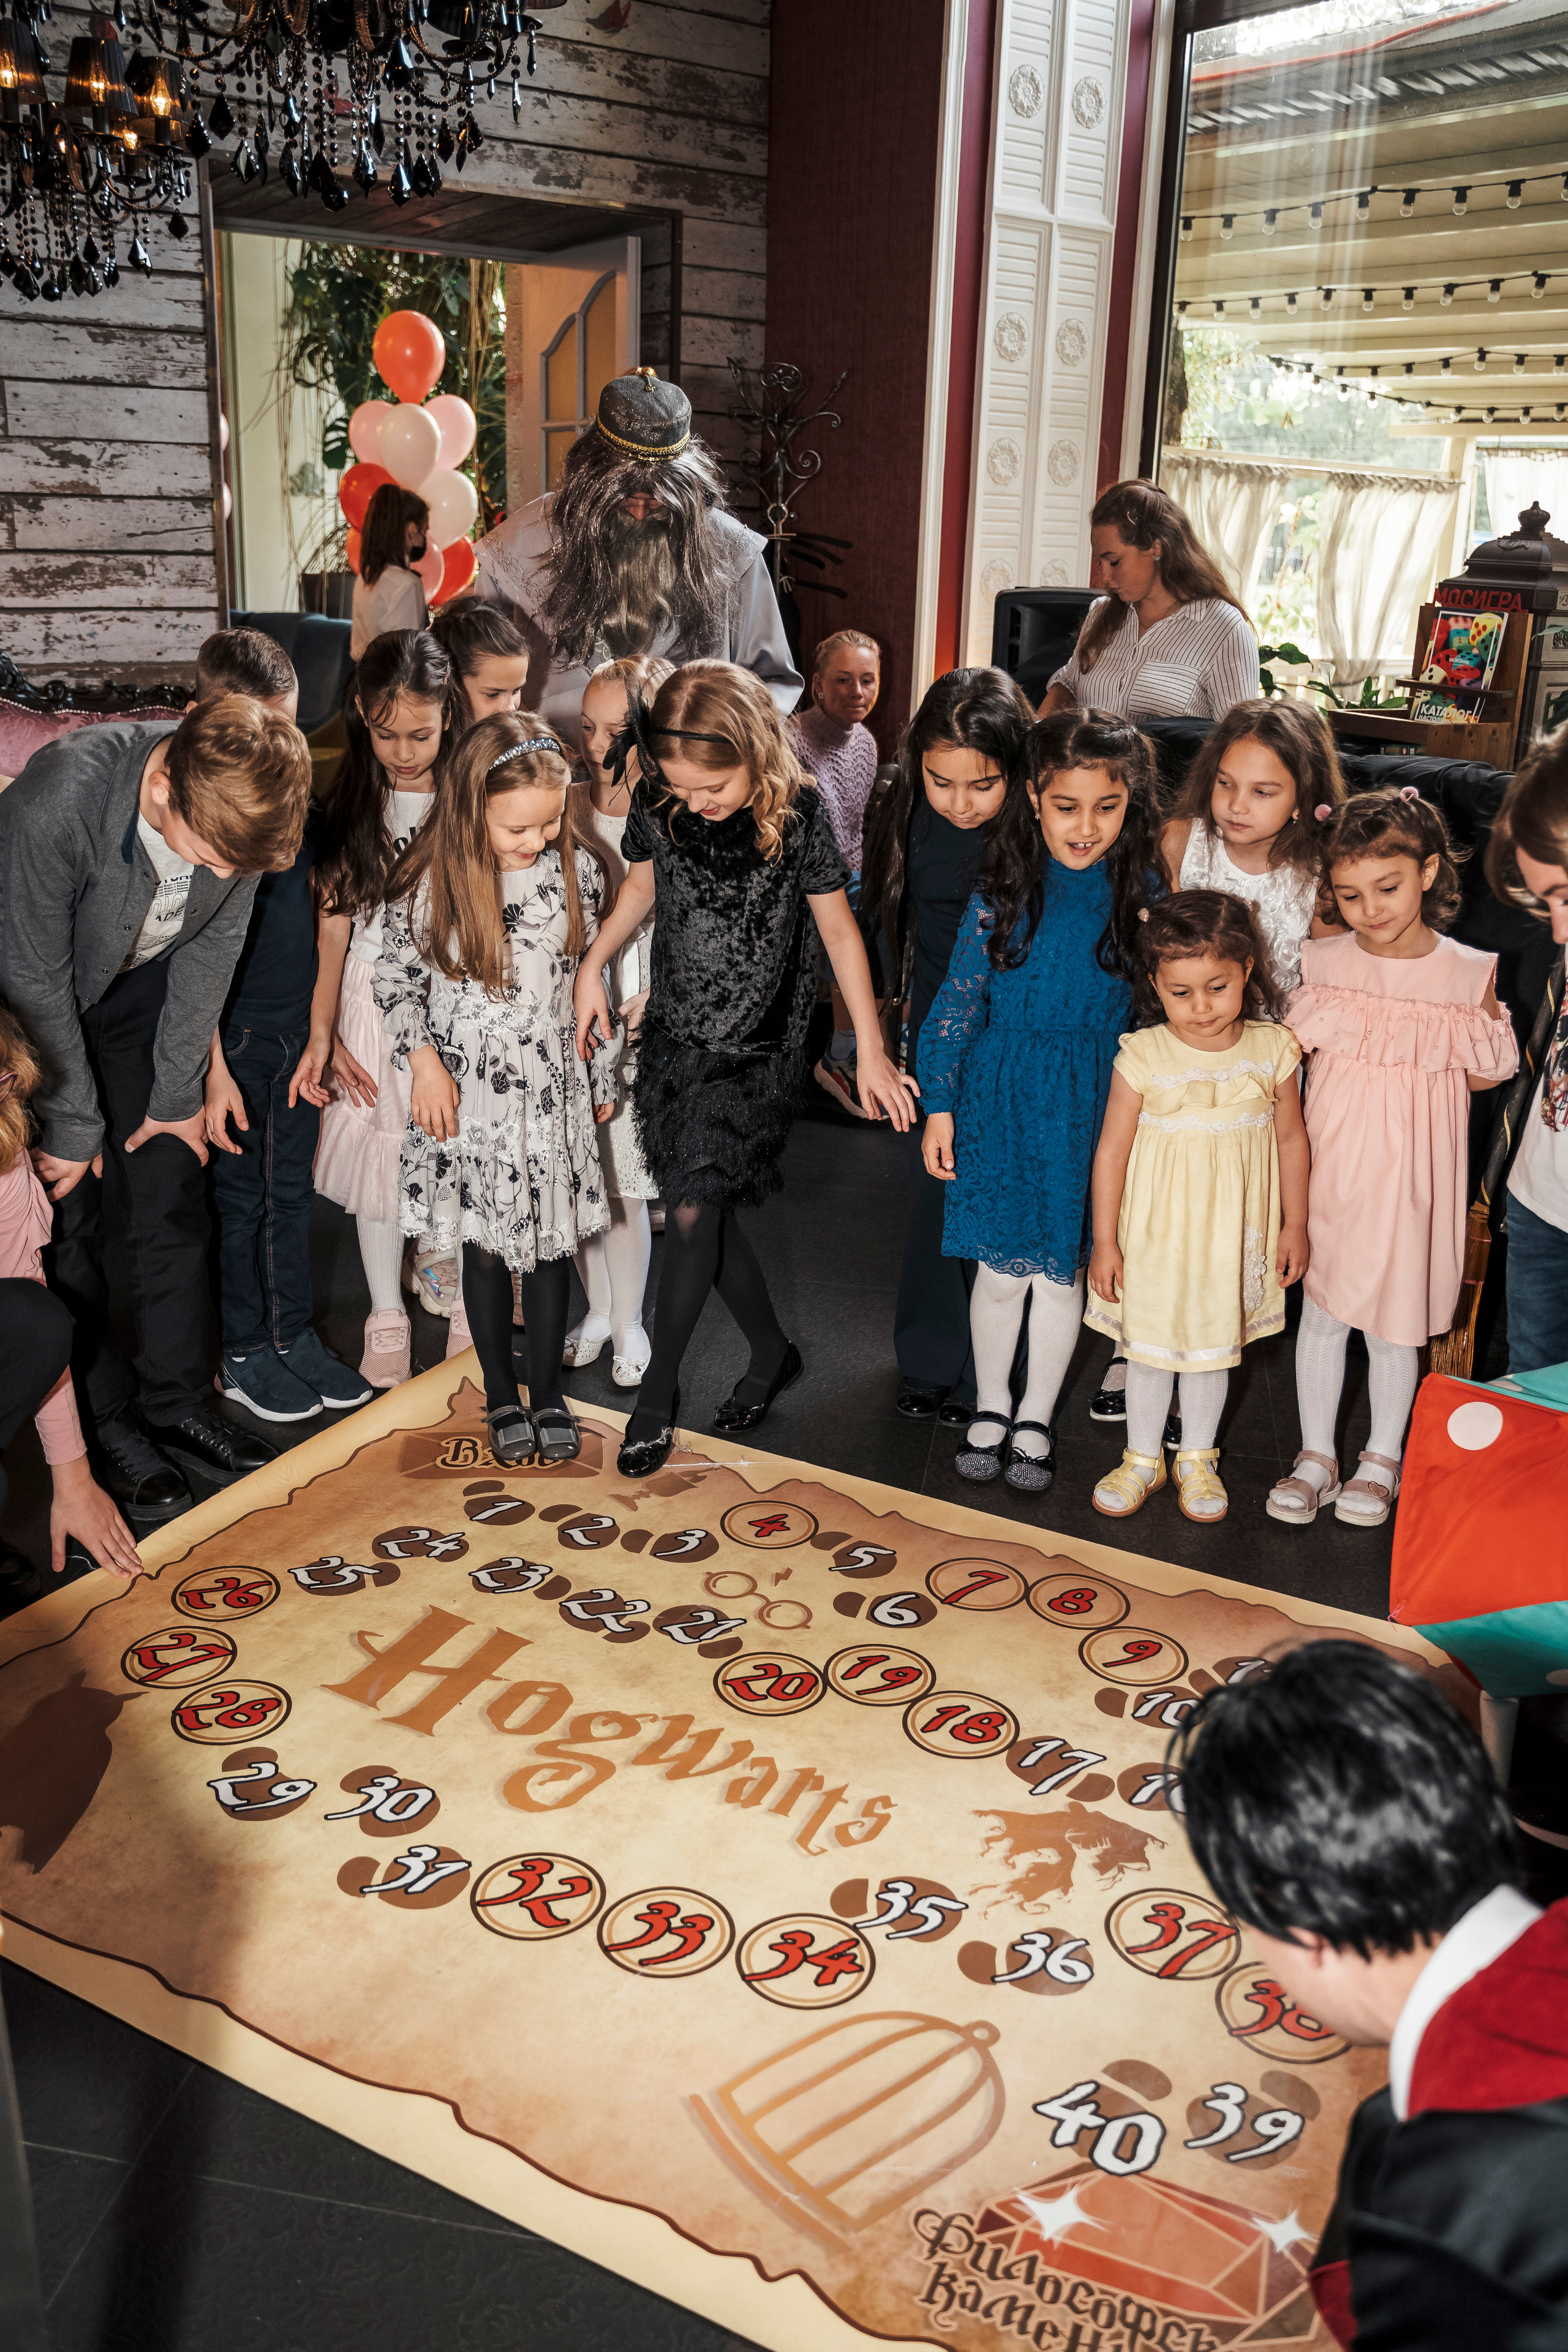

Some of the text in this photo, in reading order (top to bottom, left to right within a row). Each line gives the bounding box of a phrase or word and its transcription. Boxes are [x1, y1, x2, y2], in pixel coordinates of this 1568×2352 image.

[1433, 587, 1521, 612] МОСИГРА
[1420, 704, 1472, 720] КАТАЛОГ
[470, 1501, 525, 1522] 1
[748, 1513, 791, 1537] 4
[379, 1529, 465, 1558] 24
[560, 1516, 615, 1547] 2
[654, 1529, 708, 1557] 3
[287, 1556, 382, 1589] 25
[469, 1556, 553, 1594] 23
[828, 1546, 897, 1572] 5
[179, 1577, 273, 1609] 26
[941, 1570, 1009, 1604] 7
[1047, 1587, 1098, 1615] 8
[559, 1588, 651, 1634] 22
[660, 1611, 747, 1645] 21
[870, 1594, 922, 1627] 6
[130, 1632, 233, 1683] 27
[1101, 1640, 1163, 1668] 9
[723, 1663, 819, 1702] 20
[841, 1654, 923, 1695] 19
[172, 1691, 281, 1731] 28
[920, 1705, 1008, 1744] 18
[1131, 1691, 1202, 1728] 10
[320, 1605, 899, 1857] Hogwarts
[1017, 1738, 1107, 1796] 17
[206, 1762, 317, 1812] 29
[323, 1775, 435, 1822] 30
[359, 1844, 472, 1894] 31
[475, 1857, 593, 1928] 32
[854, 1880, 969, 1940] 35
[603, 1901, 715, 1967] 33
[1125, 1902, 1239, 1979] 37
[741, 1929, 865, 1987] 34
[991, 1931, 1095, 1985] 36
[1033, 2079, 1167, 2176] 40
[1183, 2082, 1306, 2162] 39
